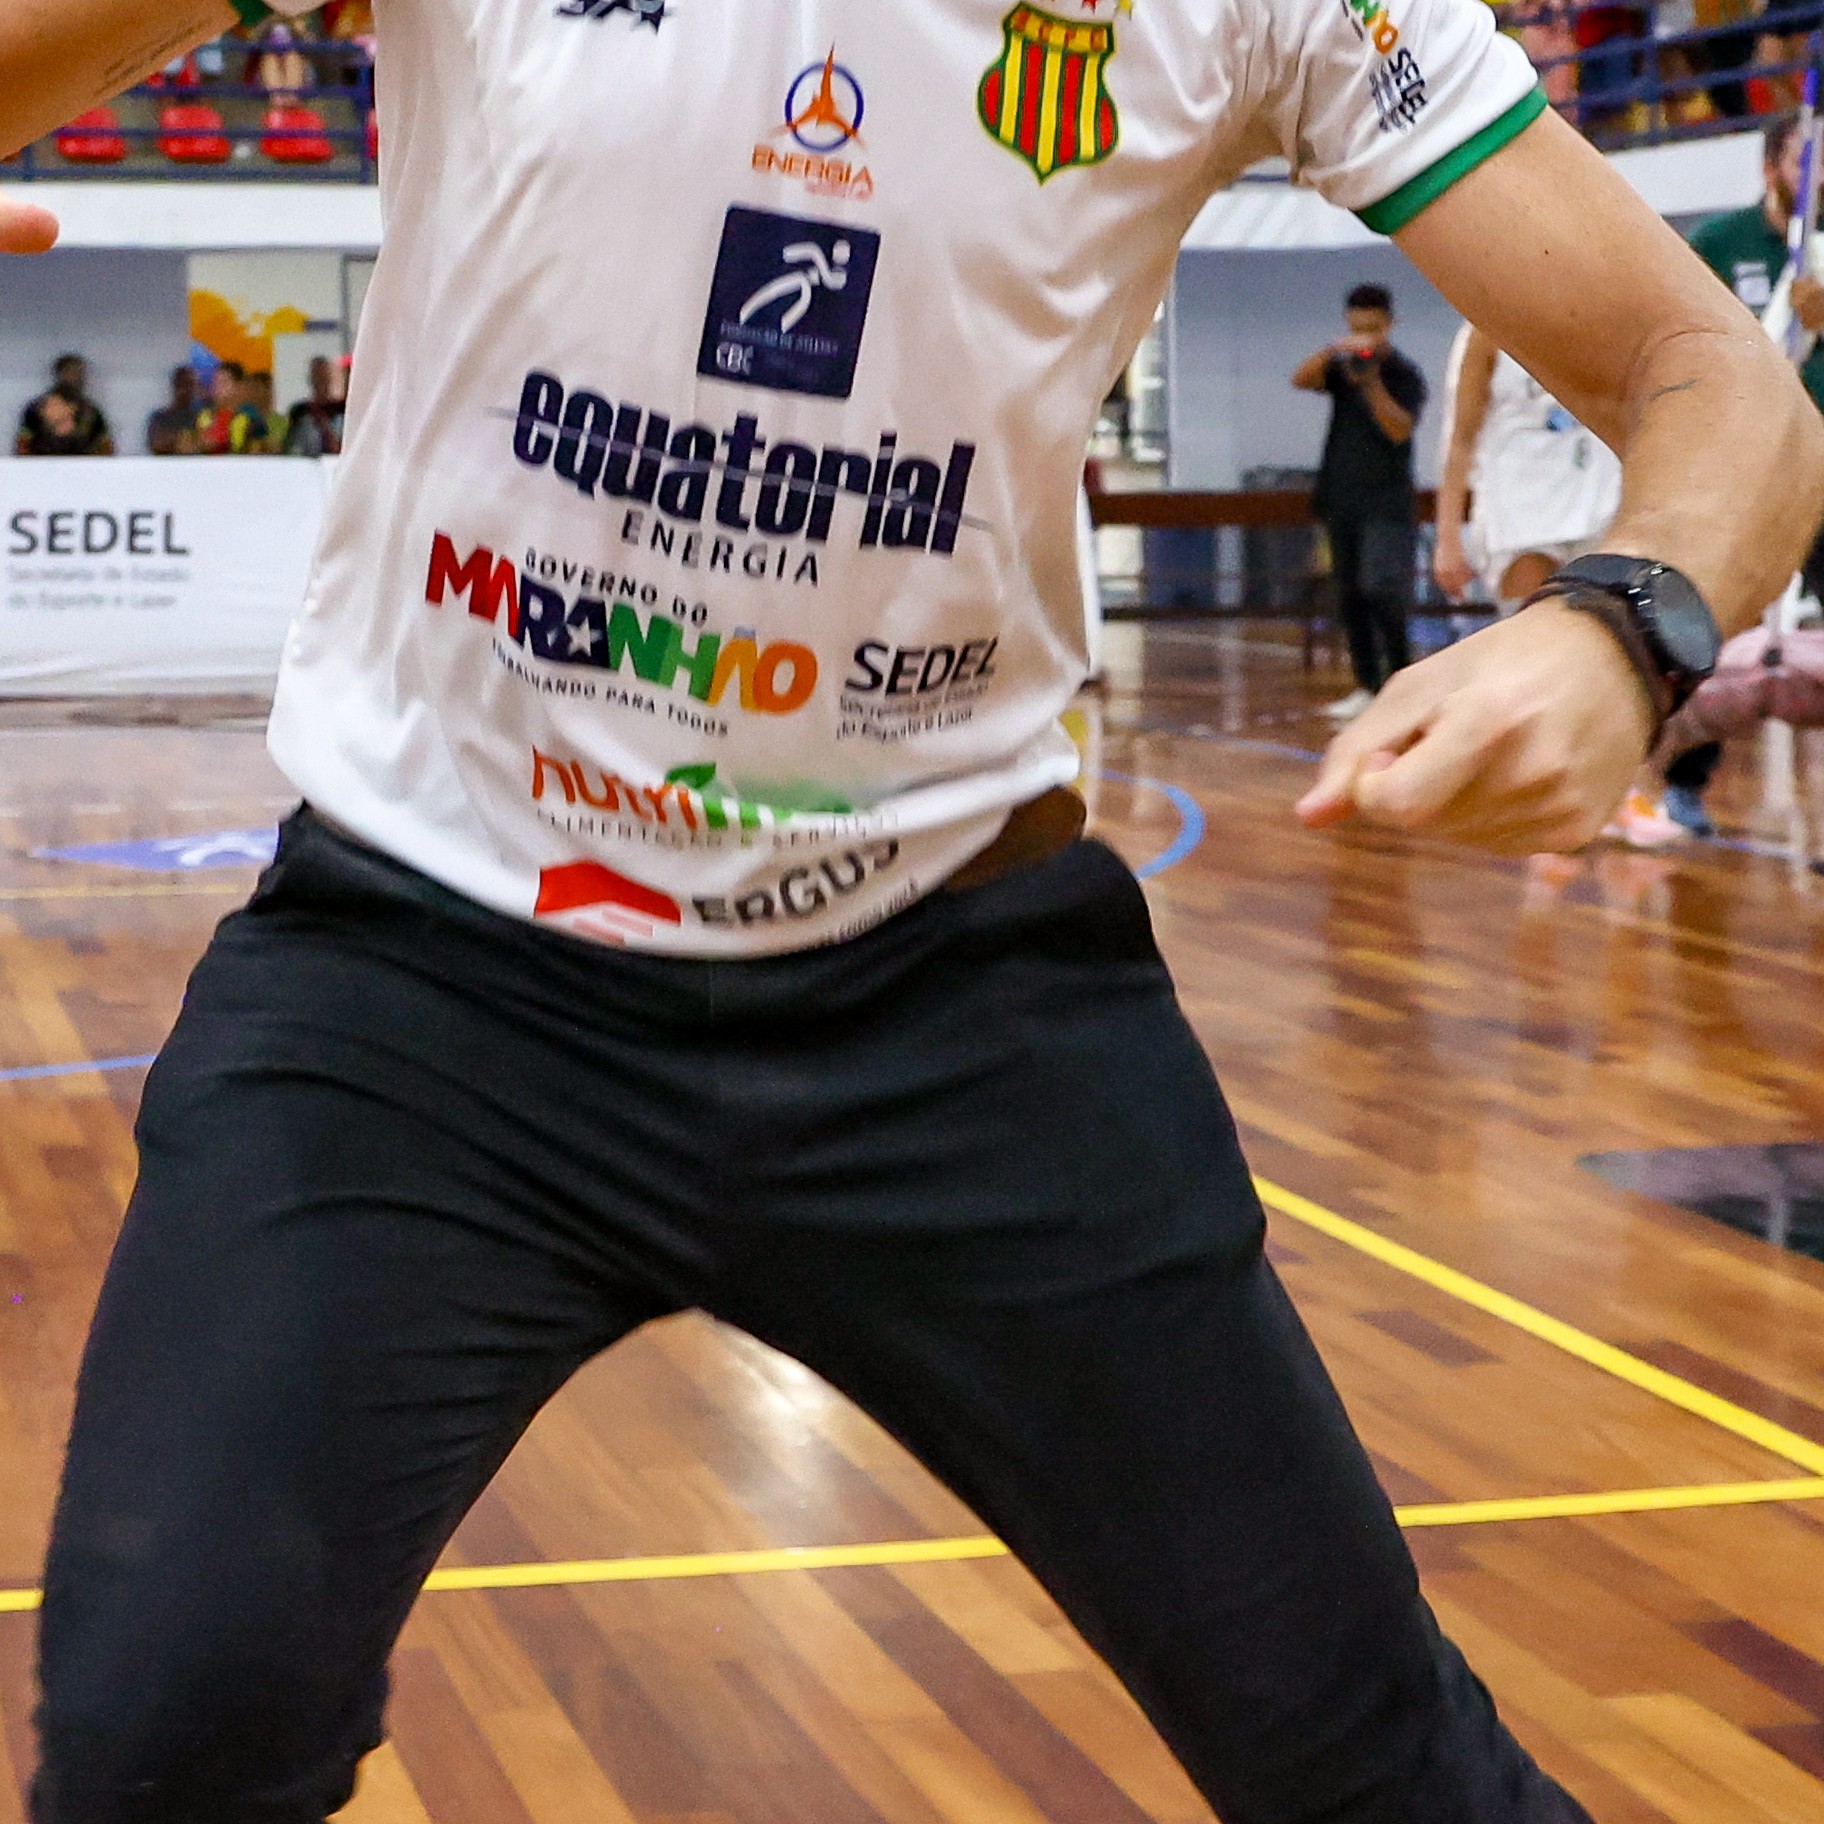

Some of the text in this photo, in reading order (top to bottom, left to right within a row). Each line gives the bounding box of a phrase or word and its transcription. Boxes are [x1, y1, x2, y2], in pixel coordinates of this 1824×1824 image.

[513, 368, 976, 558] equatorial
[7, 510, 191, 555] SEDEL
[622, 509, 819, 588] ENERGIA
[425, 528, 818, 716] MARANHÃO
[525, 546, 708, 626] GOVERNO DO
[606, 685, 656, 715] PARA
[845, 636, 999, 696] SEDEL
